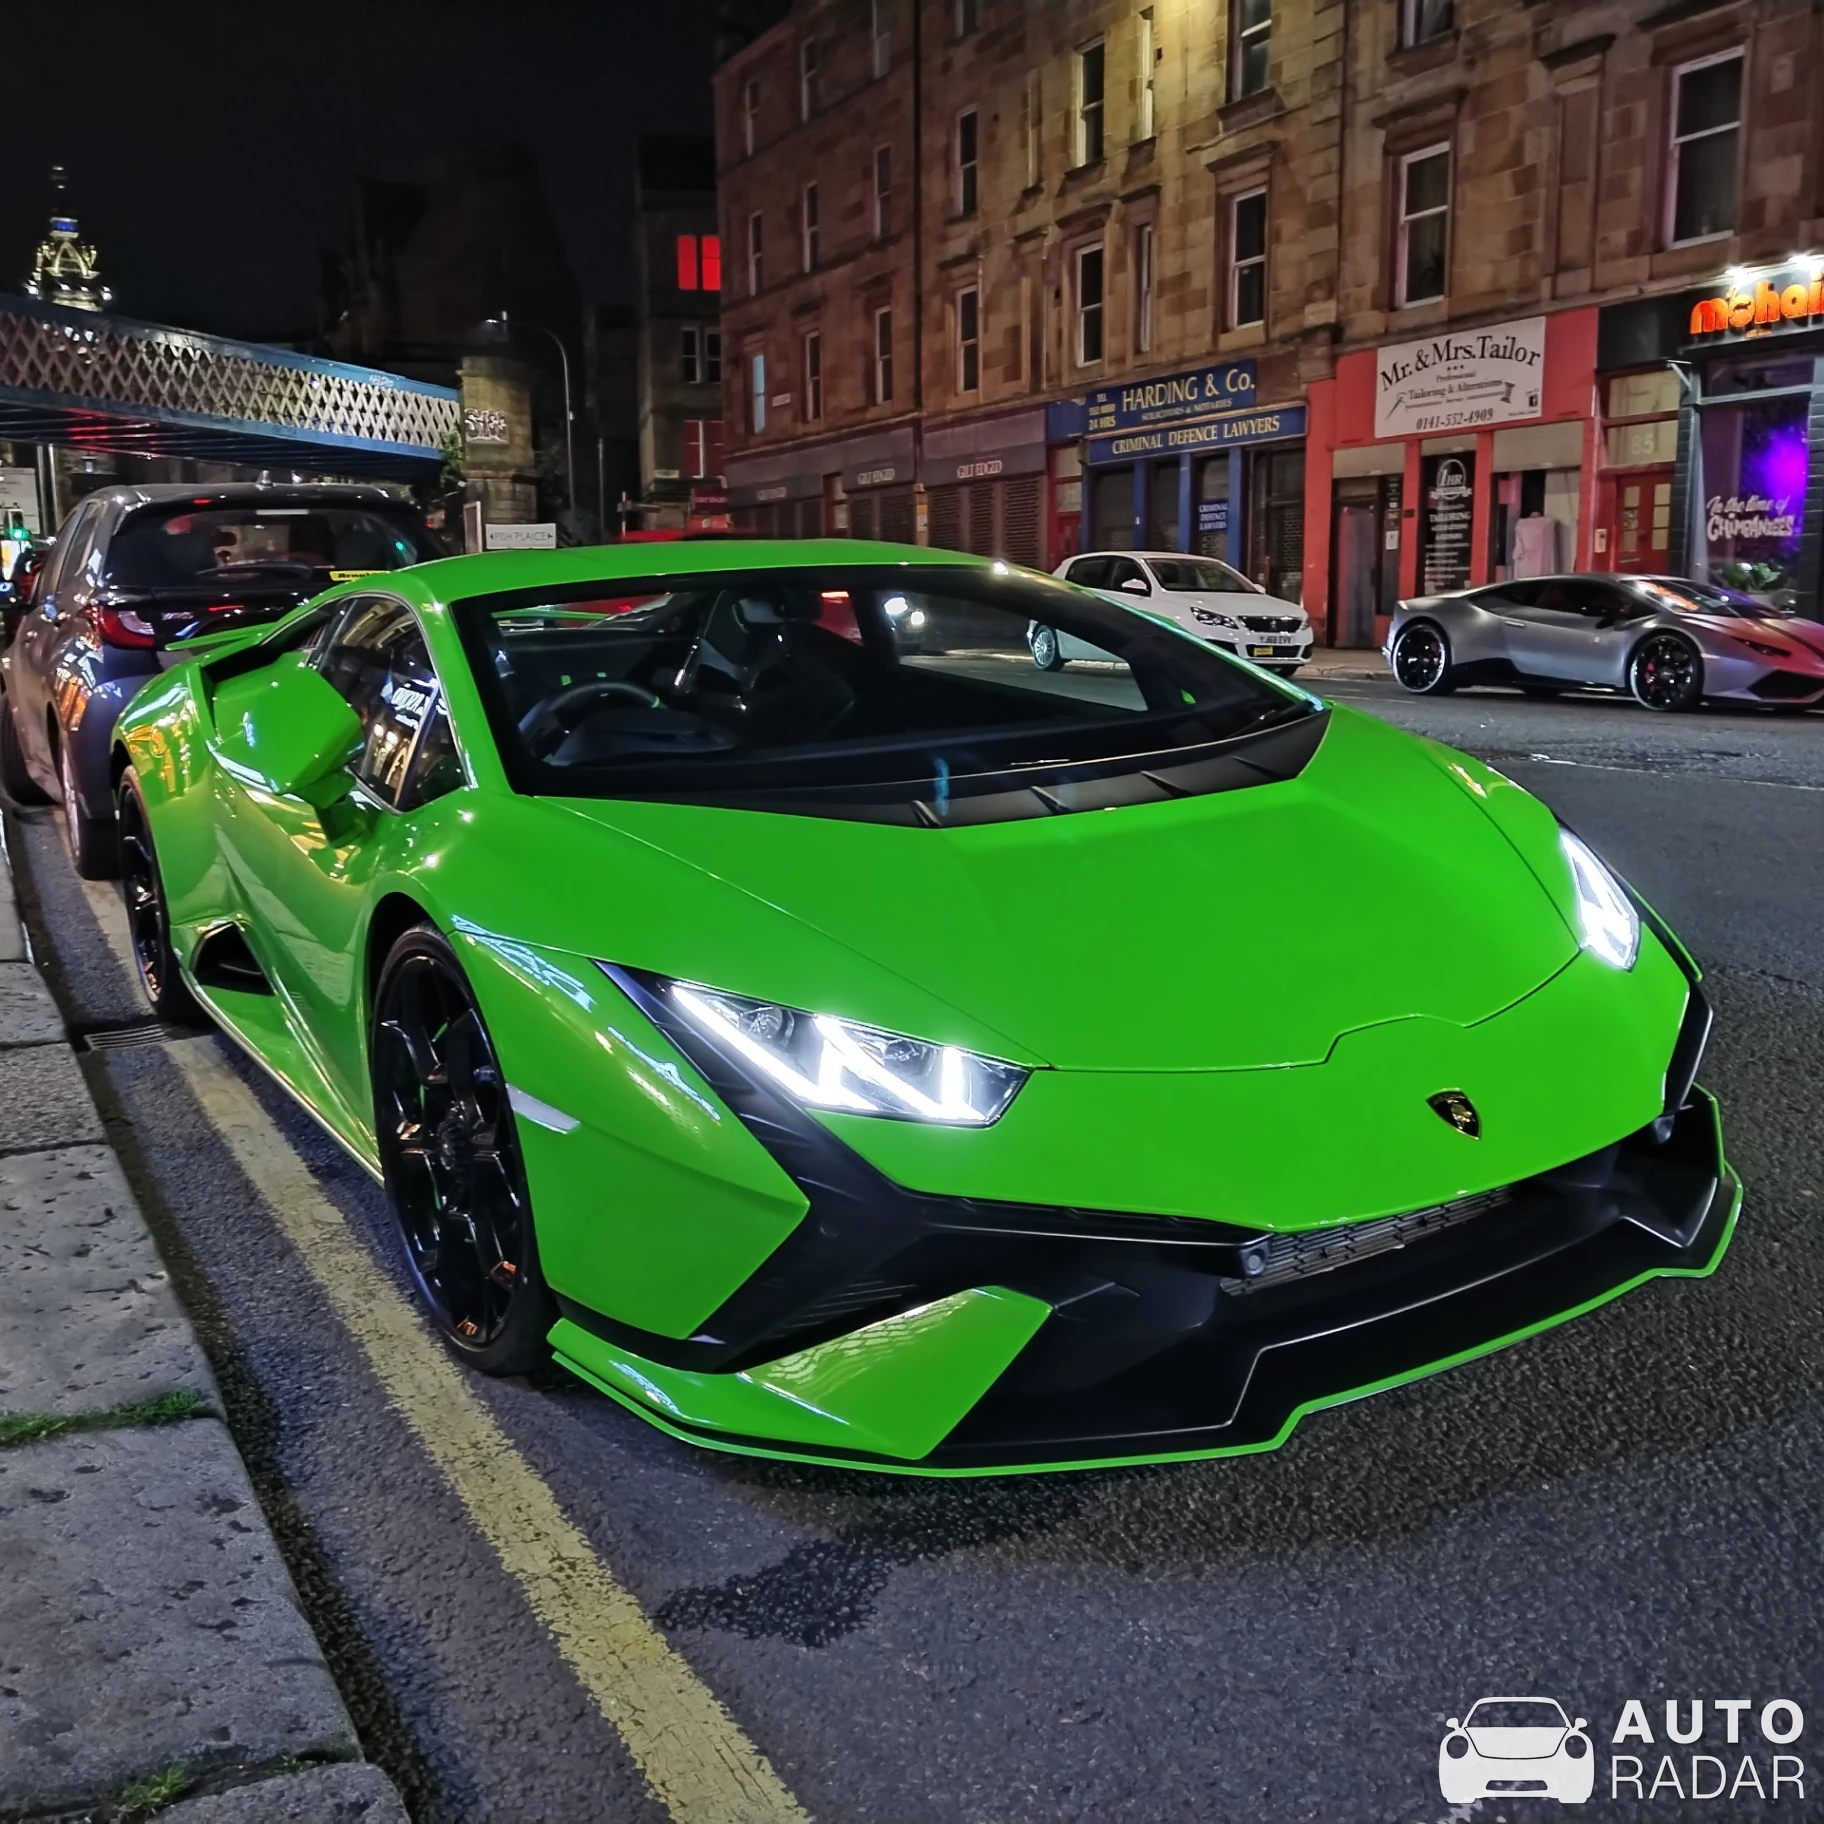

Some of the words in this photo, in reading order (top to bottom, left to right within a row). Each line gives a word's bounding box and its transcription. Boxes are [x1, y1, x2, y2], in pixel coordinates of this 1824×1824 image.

[1690, 266, 1824, 334] mohai
[1380, 361, 1413, 392] Mr.
[1476, 335, 1541, 366] Tailor
[1122, 376, 1198, 412] HARDING
[1204, 373, 1220, 397] &
[1225, 368, 1256, 393] Co.
[1408, 388, 1446, 400] Tailoring
[1088, 418, 1099, 431] 24
[1099, 415, 1116, 429] HRS
[1112, 433, 1164, 454] CRIMINAL
[1168, 424, 1218, 446] DEFENCE
[1223, 415, 1280, 438] LAWYERS
[1706, 495, 1723, 516] In
[1724, 496, 1745, 513] the
[1745, 494, 1774, 512] time
[1775, 494, 1791, 516] of
